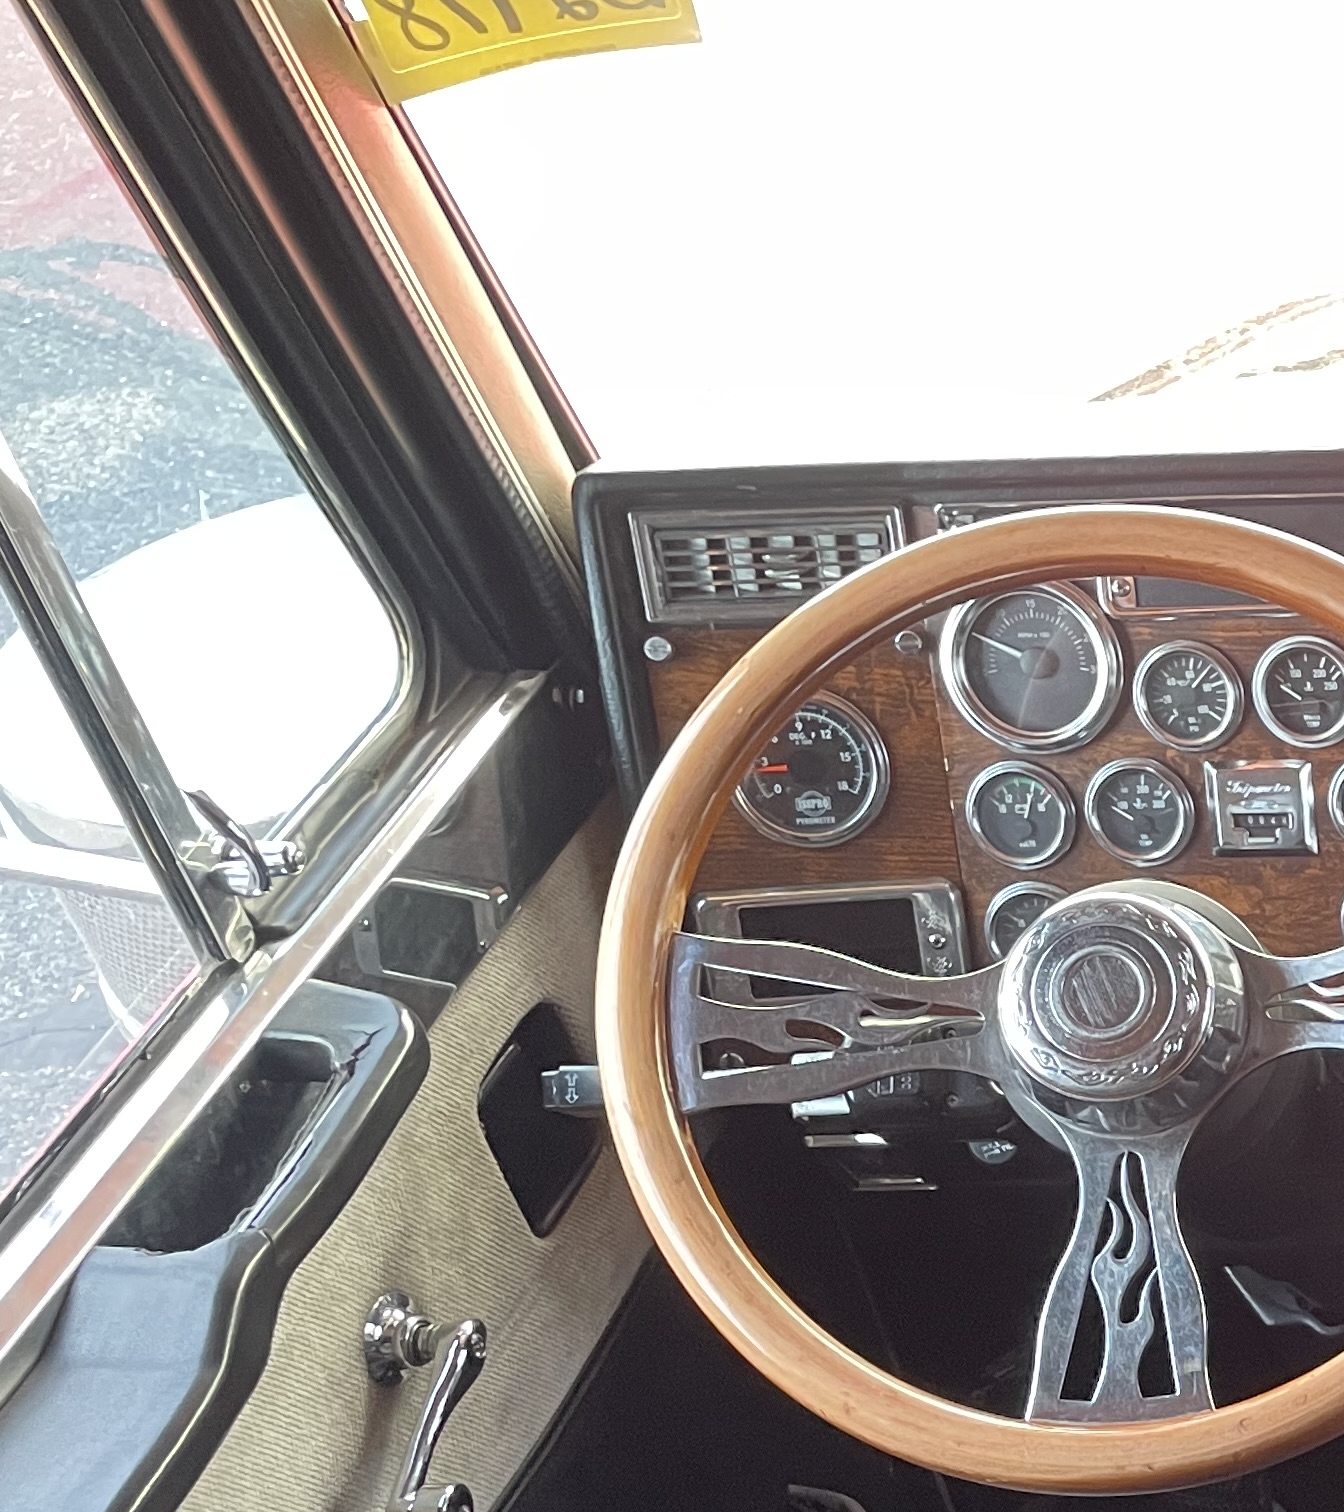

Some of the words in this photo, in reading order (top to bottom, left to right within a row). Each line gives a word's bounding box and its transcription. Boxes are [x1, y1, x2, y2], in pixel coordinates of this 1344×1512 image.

[1025, 599, 1036, 608] 15
[795, 721, 803, 732] 9
[820, 729, 832, 740] 12
[839, 752, 851, 763] 15
[774, 783, 782, 794] 0
[837, 781, 849, 791] 18
[796, 816, 836, 825] PYROMETER
